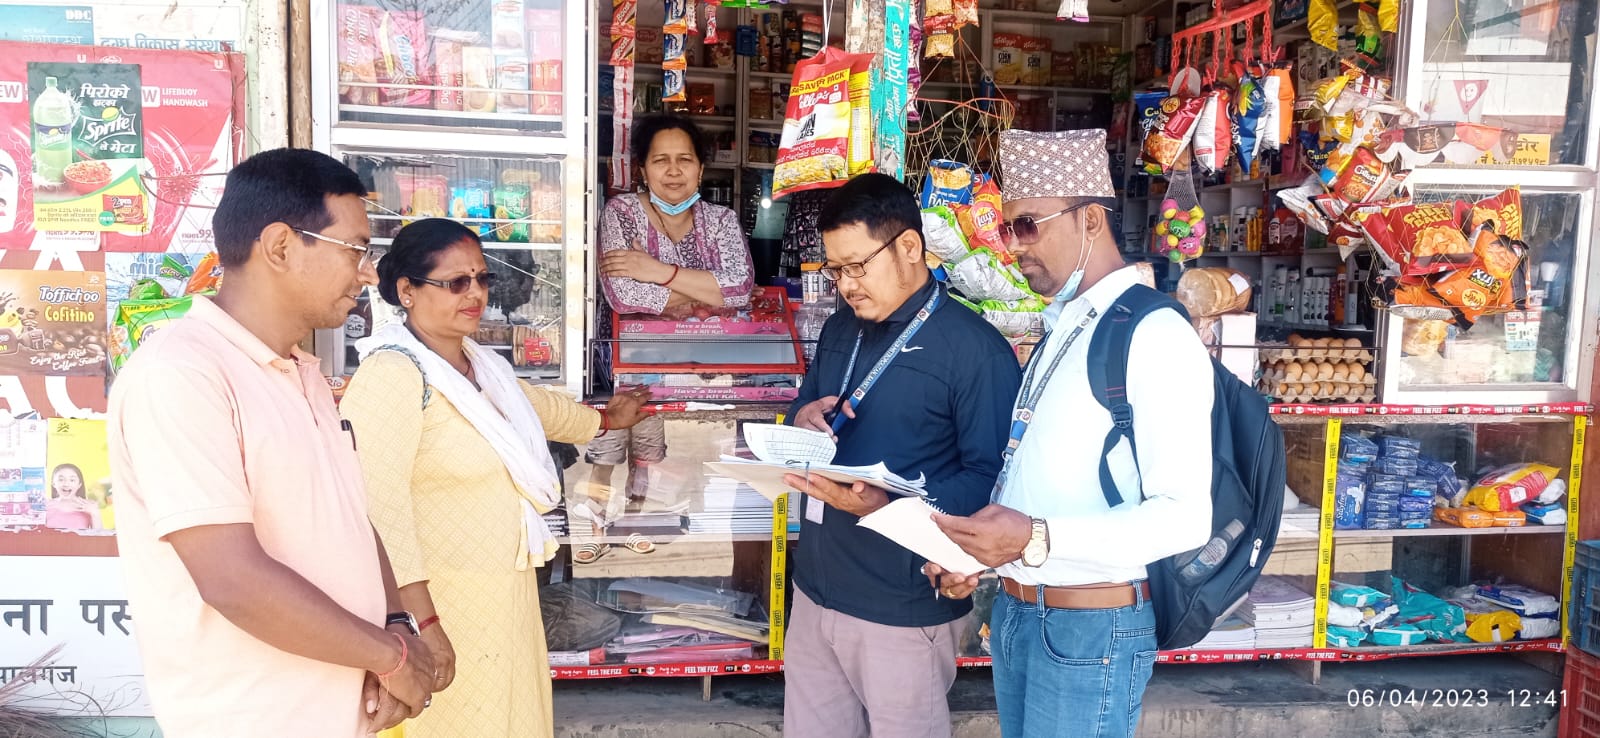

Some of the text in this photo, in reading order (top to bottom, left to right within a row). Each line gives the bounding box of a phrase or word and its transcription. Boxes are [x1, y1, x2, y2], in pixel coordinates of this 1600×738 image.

[827, 71, 845, 84] PACK
[0, 83, 21, 101] EW
[162, 88, 197, 96] LIFEBUOY
[162, 98, 208, 107] HANDWASH
[85, 116, 130, 141] Sprite
[1516, 138, 1539, 152] टोर
[45, 305, 95, 322] Cofitino
[1336, 492, 1347, 520] Stayfree
[0, 599, 132, 635] ना पस
